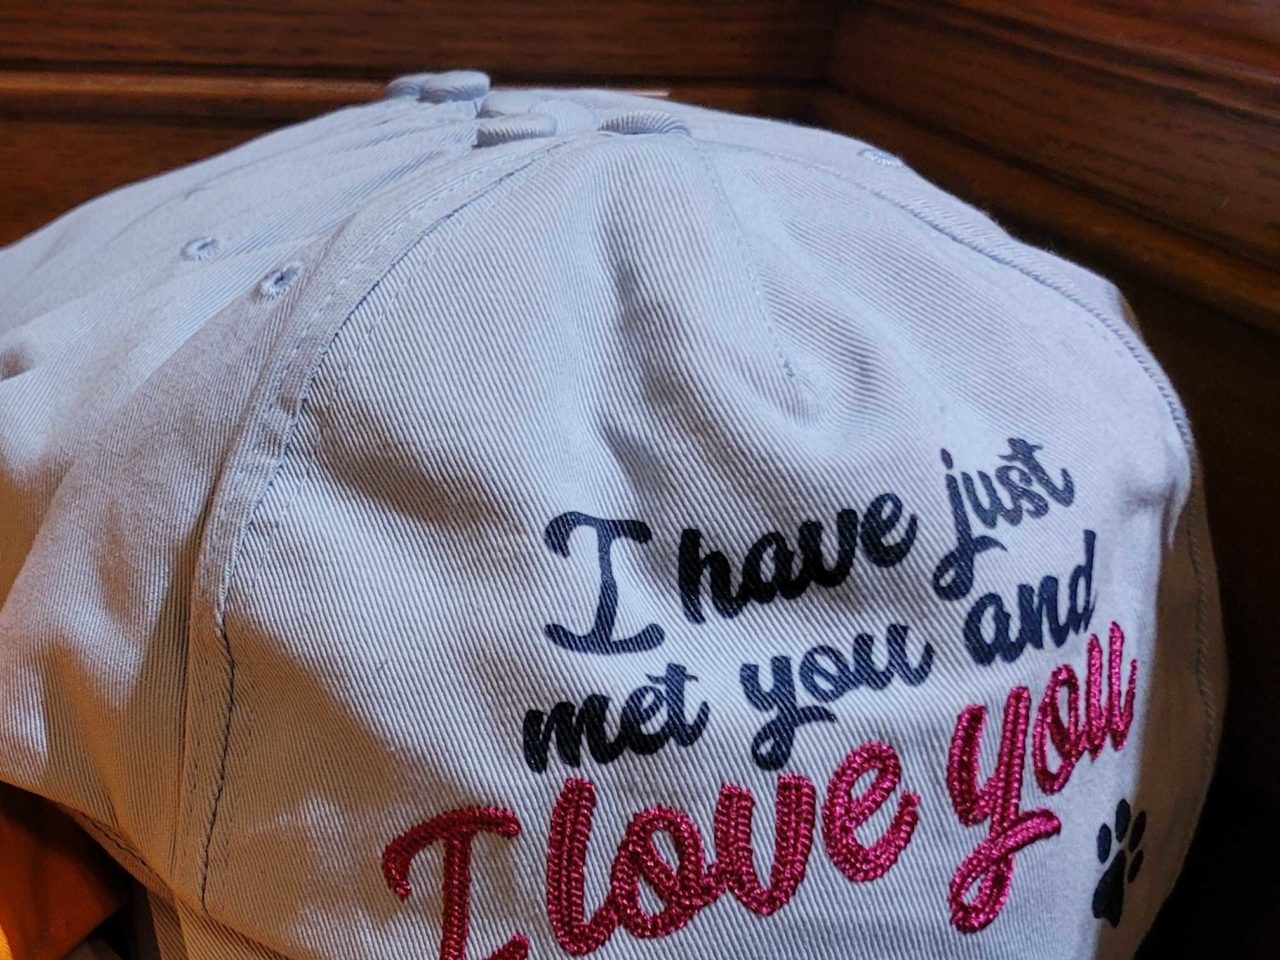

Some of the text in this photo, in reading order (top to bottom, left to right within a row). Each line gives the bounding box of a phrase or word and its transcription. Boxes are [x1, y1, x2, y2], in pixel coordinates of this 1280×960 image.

[520, 529, 1098, 773] met you and
[544, 436, 1076, 655] I have just
[545, 740, 920, 957] love
[946, 619, 1139, 935] you
